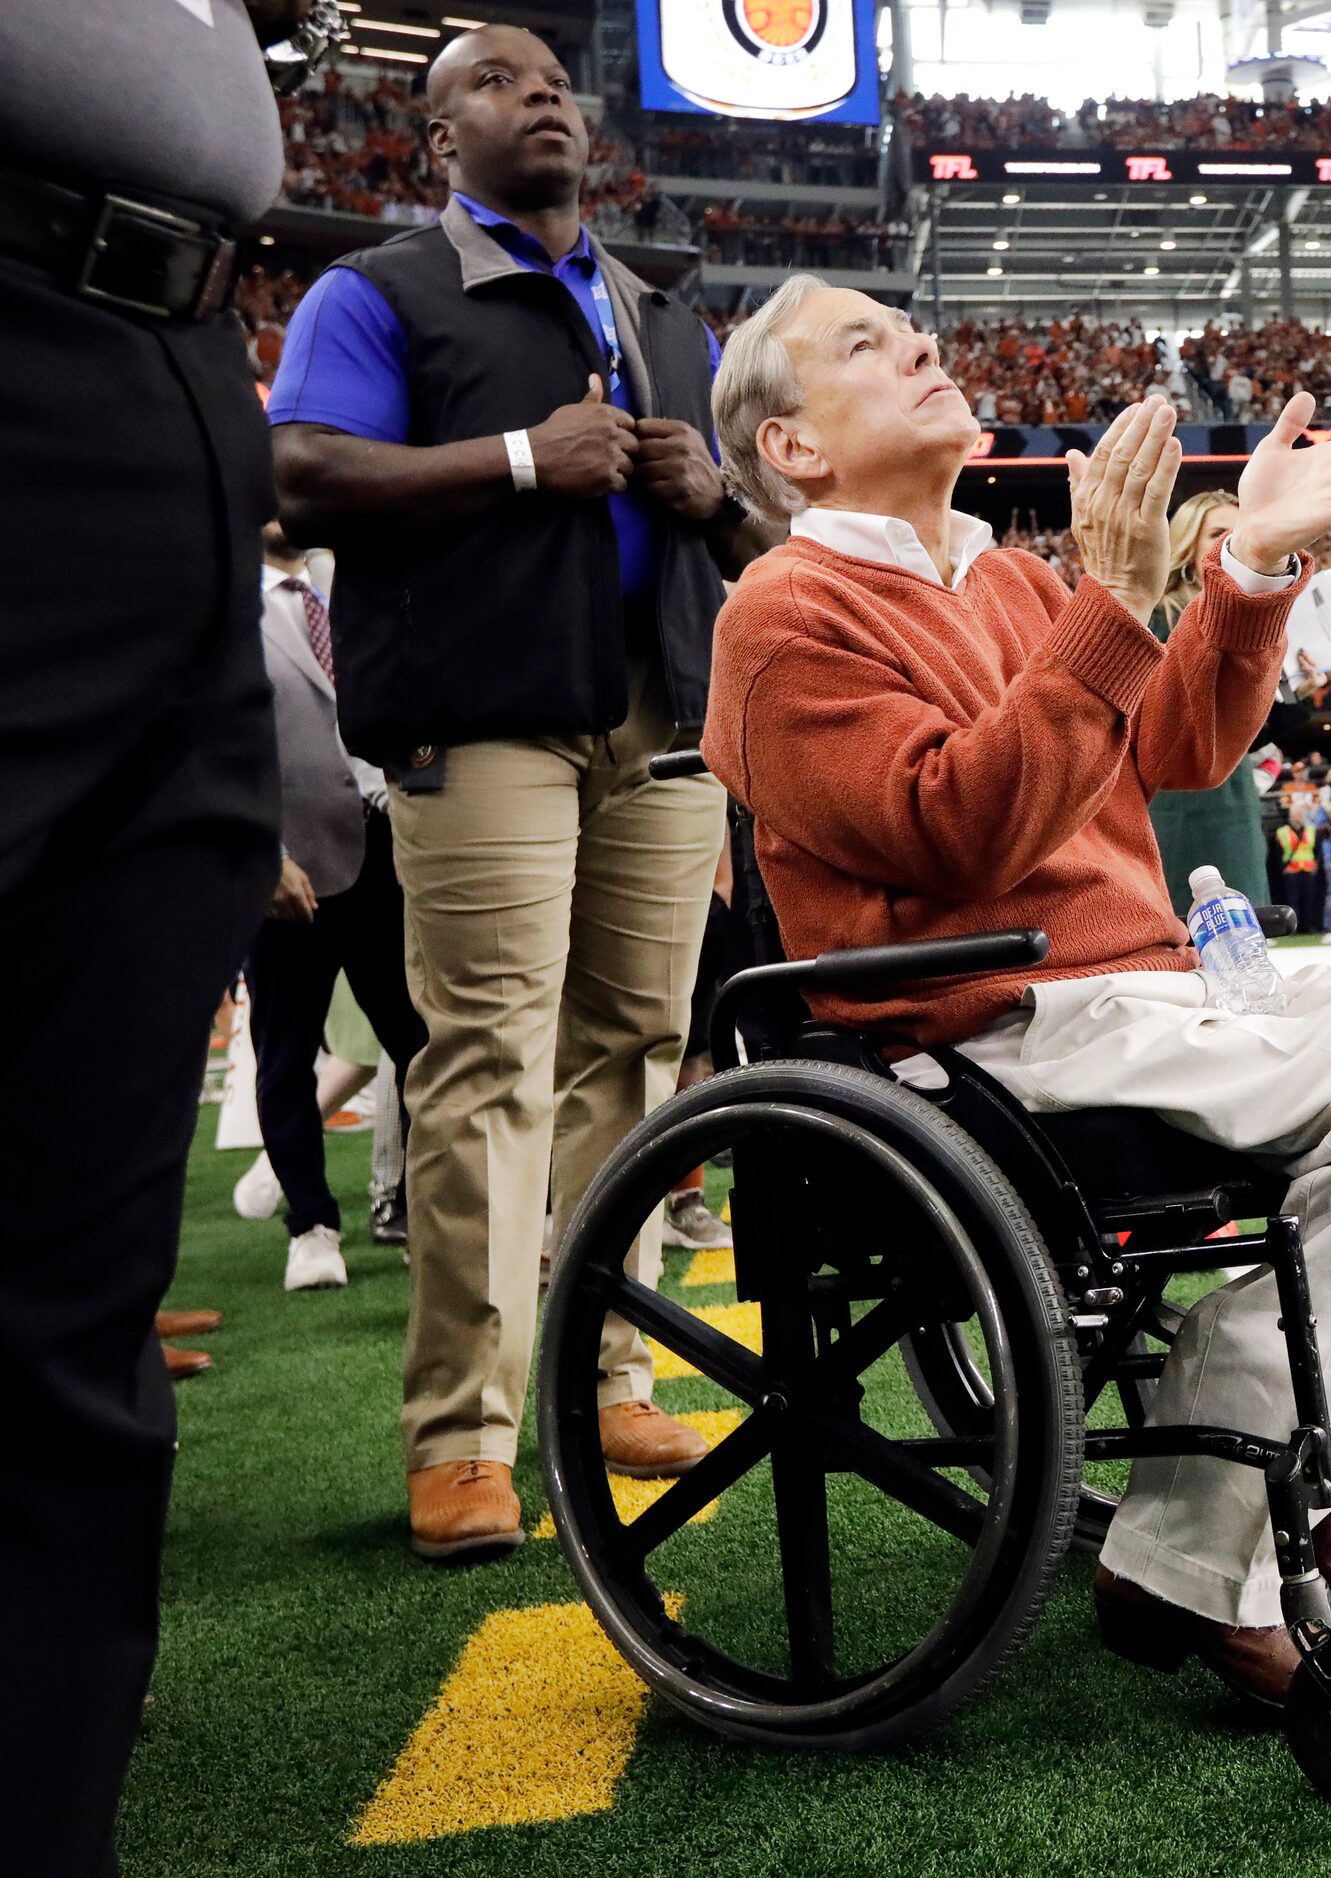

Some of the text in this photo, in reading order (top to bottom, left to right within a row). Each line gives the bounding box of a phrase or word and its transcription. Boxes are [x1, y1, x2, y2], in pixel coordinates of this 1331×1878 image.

[929, 155, 979, 180] TFL
[1125, 157, 1173, 181] TFL
[1201, 902, 1224, 921] DEJA
[1205, 913, 1228, 931] BLUE
